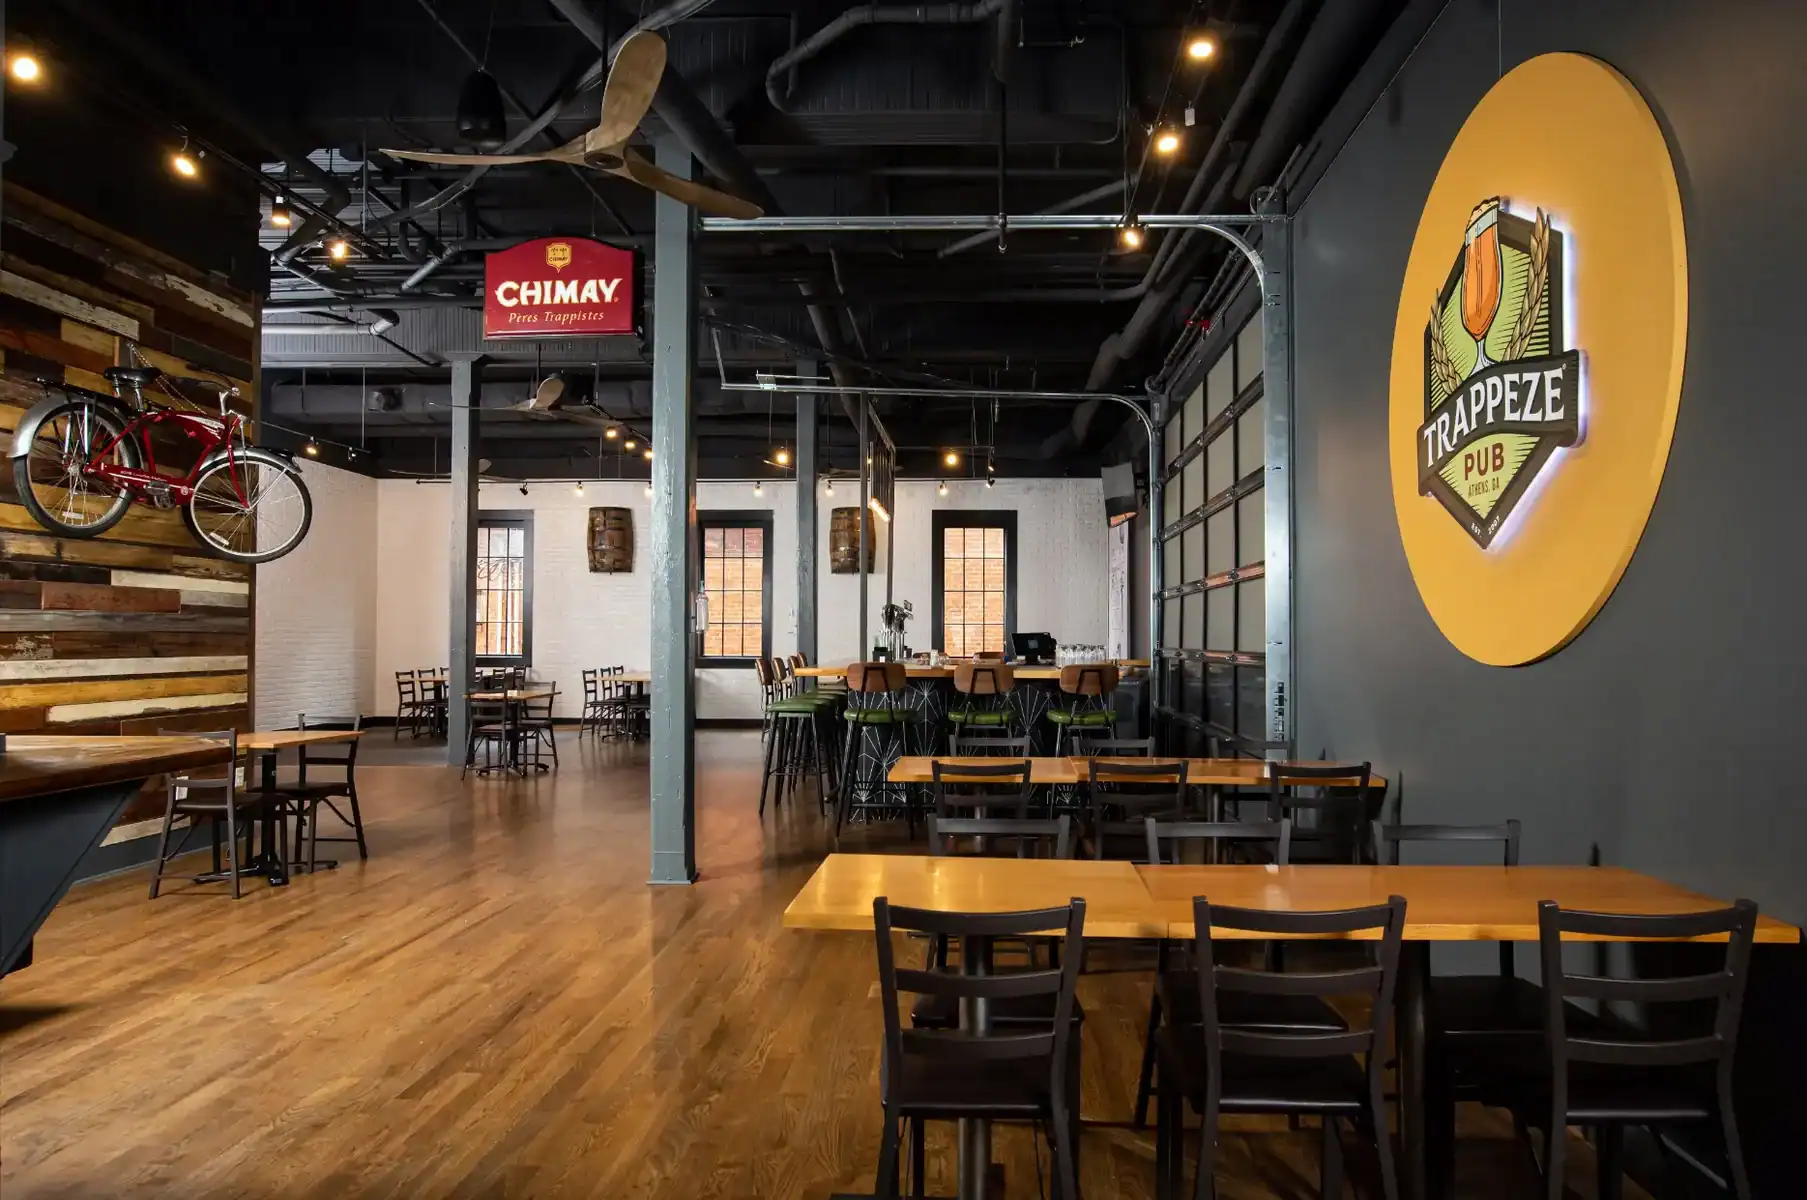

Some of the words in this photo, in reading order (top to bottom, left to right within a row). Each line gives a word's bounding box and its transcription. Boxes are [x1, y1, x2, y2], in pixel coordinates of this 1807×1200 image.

[495, 278, 623, 307] CHIMAY
[544, 310, 604, 325] Trappistes
[1424, 367, 1565, 468] TRAPPEZE
[1464, 442, 1505, 481] PUB
